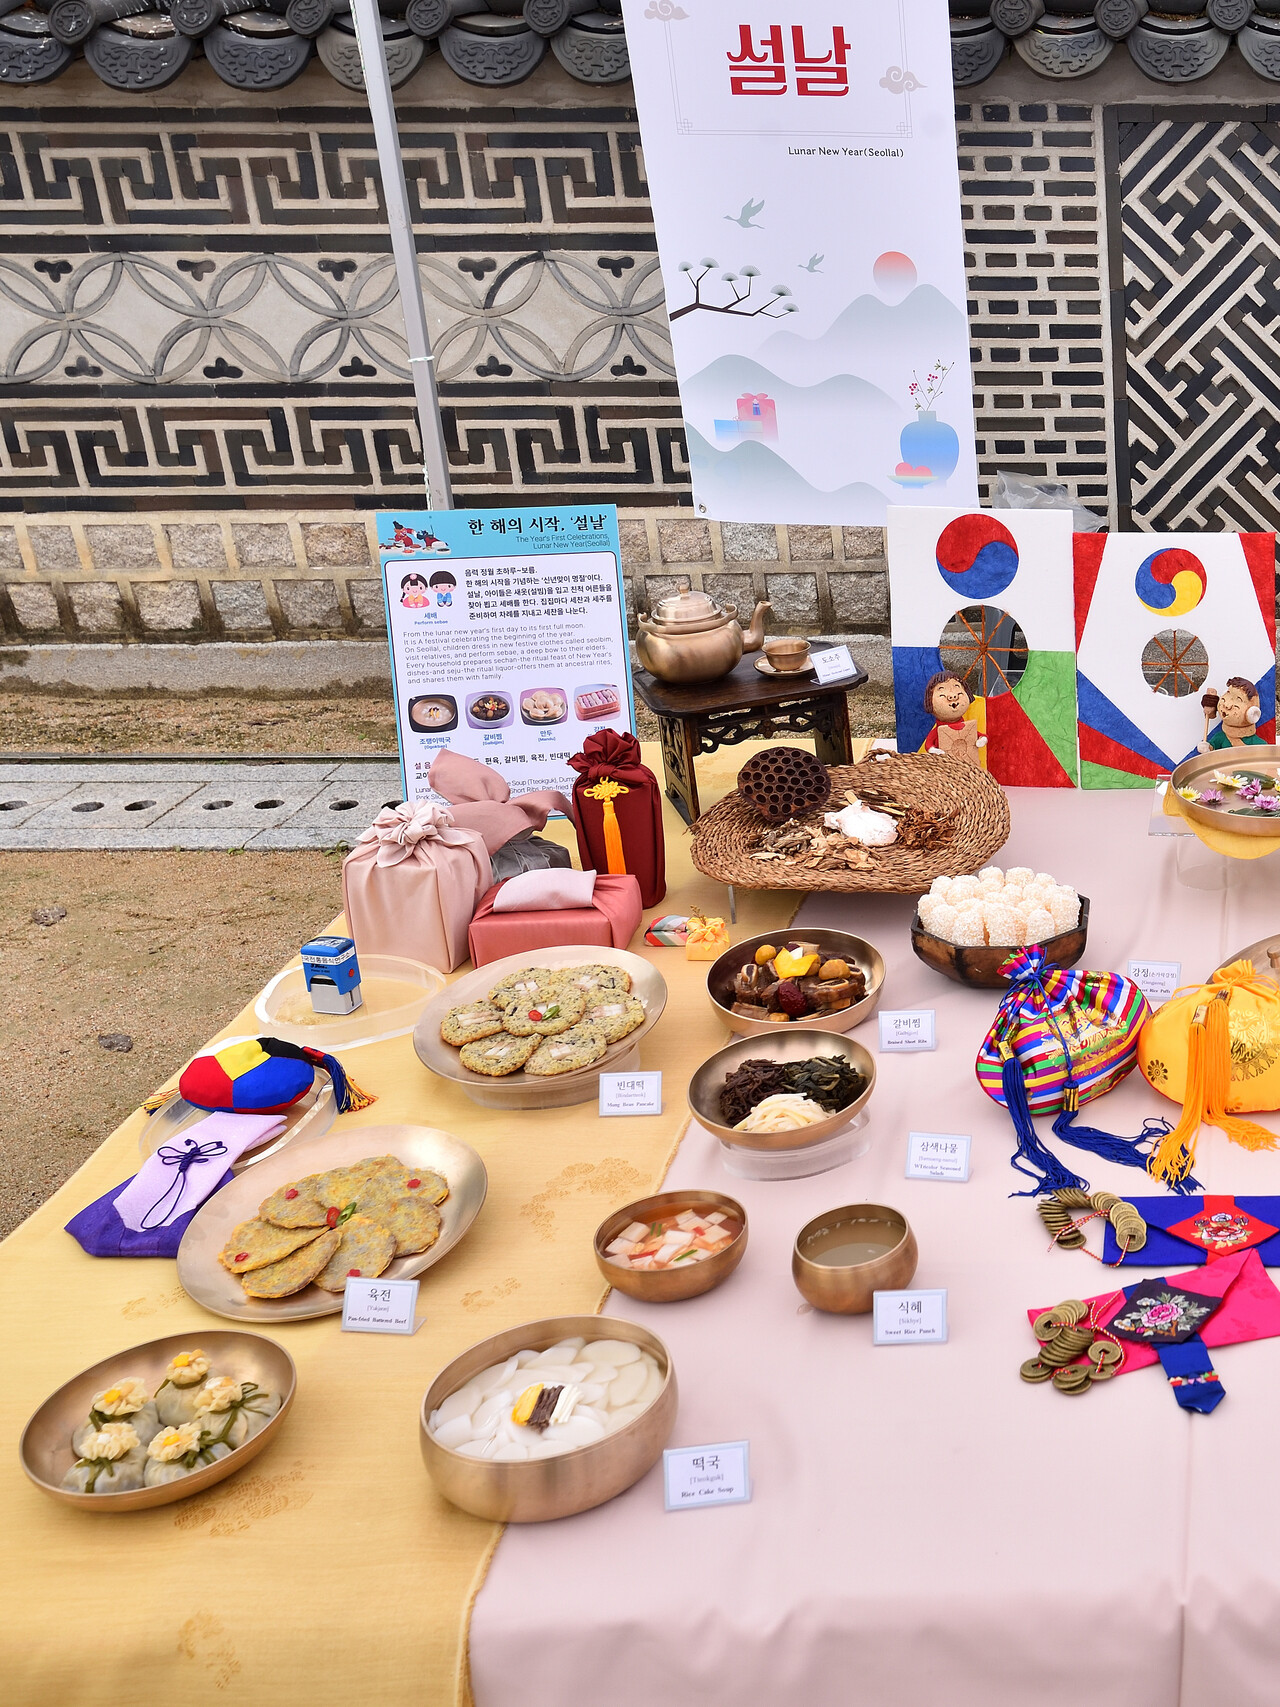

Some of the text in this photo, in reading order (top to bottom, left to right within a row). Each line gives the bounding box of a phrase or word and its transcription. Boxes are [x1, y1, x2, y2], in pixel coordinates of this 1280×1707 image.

[727, 25, 851, 96] 설날
[788, 147, 816, 155] Lunar
[842, 148, 904, 157] Year(Seollal)
[467, 519, 484, 535] 한
[490, 517, 522, 534] 해의
[529, 516, 564, 533] 시작,
[570, 540, 610, 548] Year(Seollal)
[465, 566, 537, 577] 음력 정월 초하루~보름.
[301, 952, 350, 964] 국전통음식연구소
[893, 1018, 921, 1028] 갈비찜
[617, 1080, 644, 1090] 빈대떡
[921, 1142, 958, 1154] 삼색나물
[368, 1288, 392, 1302] 육전
[898, 1301, 922, 1314] 식혜
[692, 1455, 720, 1471] 떡국
